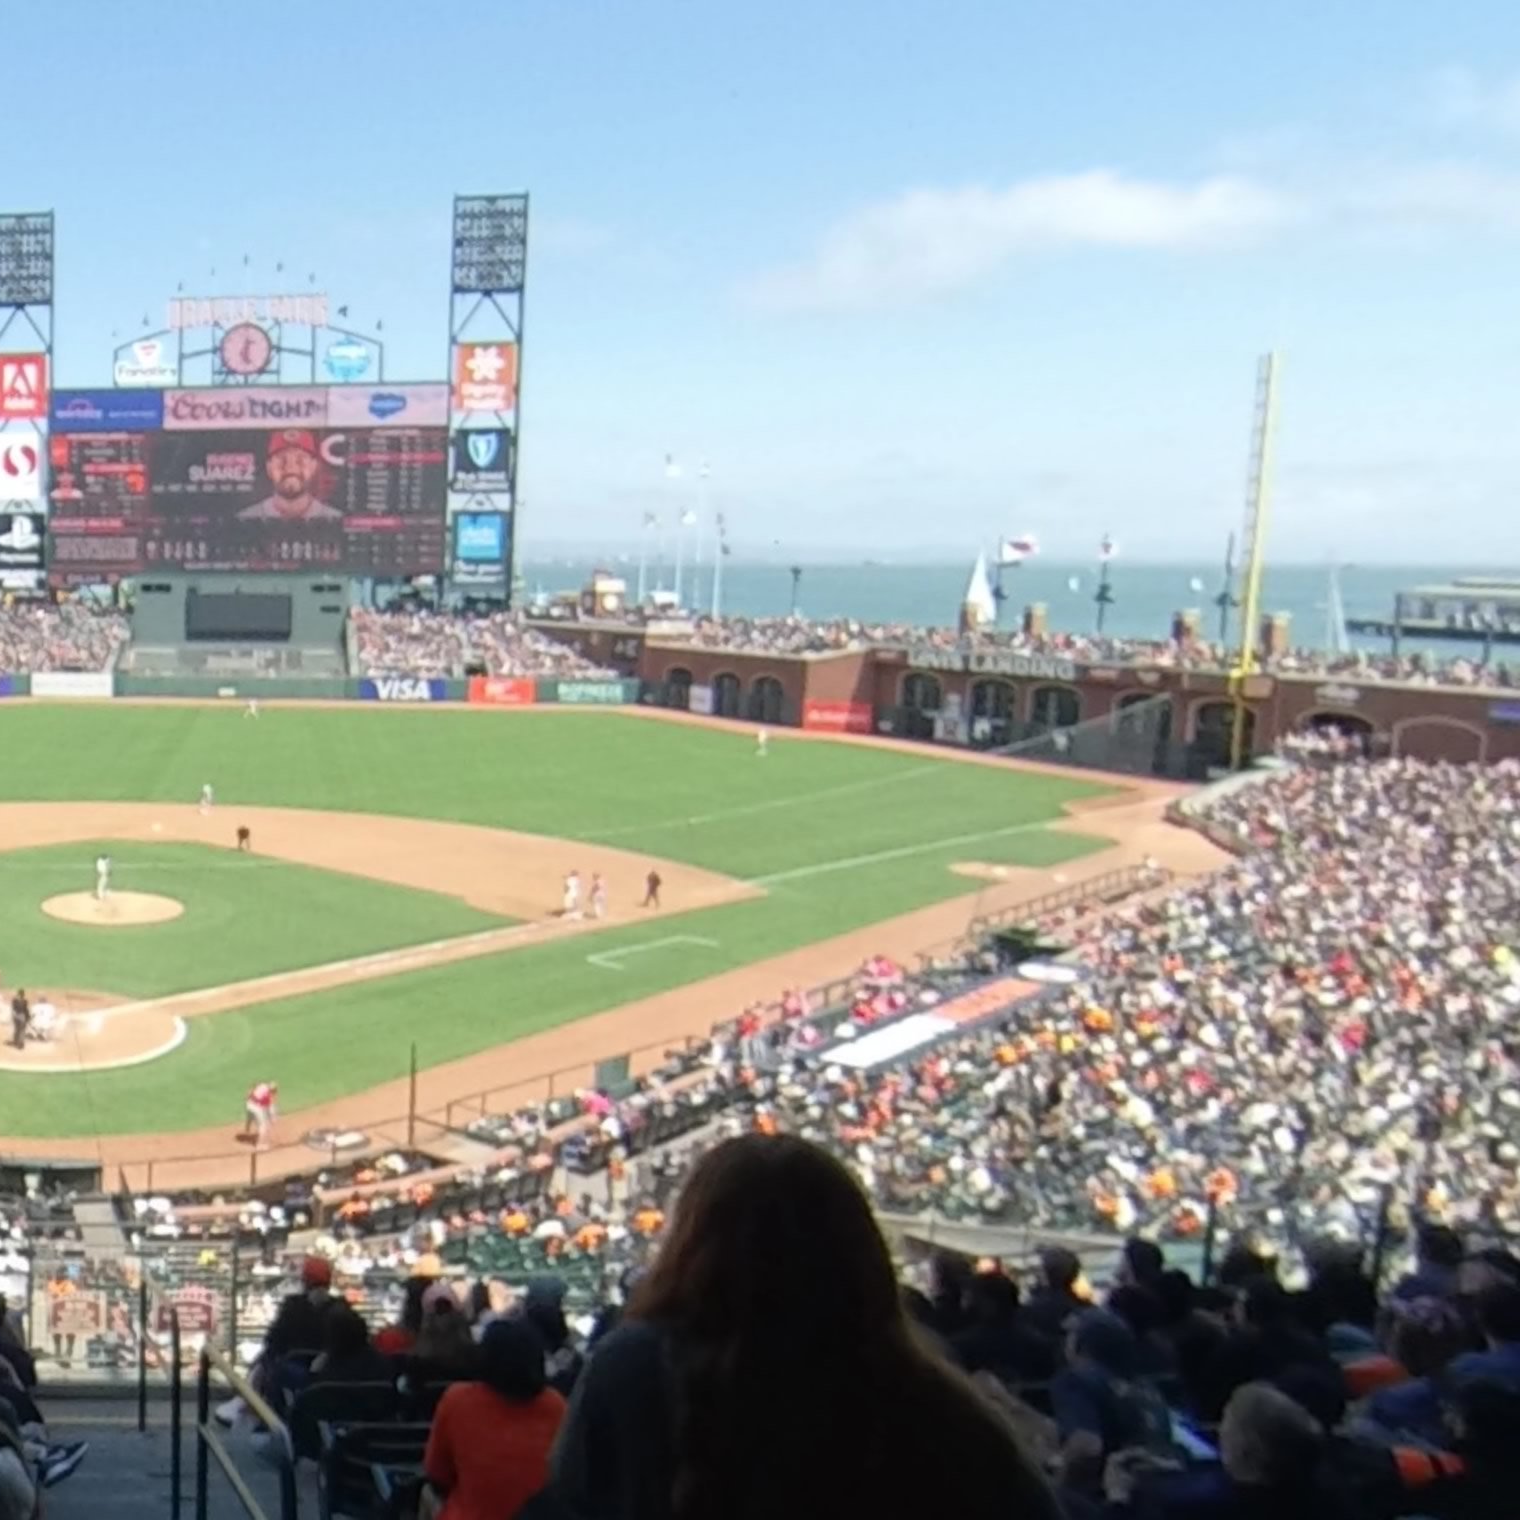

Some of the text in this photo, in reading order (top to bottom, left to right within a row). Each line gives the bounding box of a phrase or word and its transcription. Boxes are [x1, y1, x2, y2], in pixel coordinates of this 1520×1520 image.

[171, 394, 316, 421] Coors LIGHT
[374, 679, 430, 699] VISA
